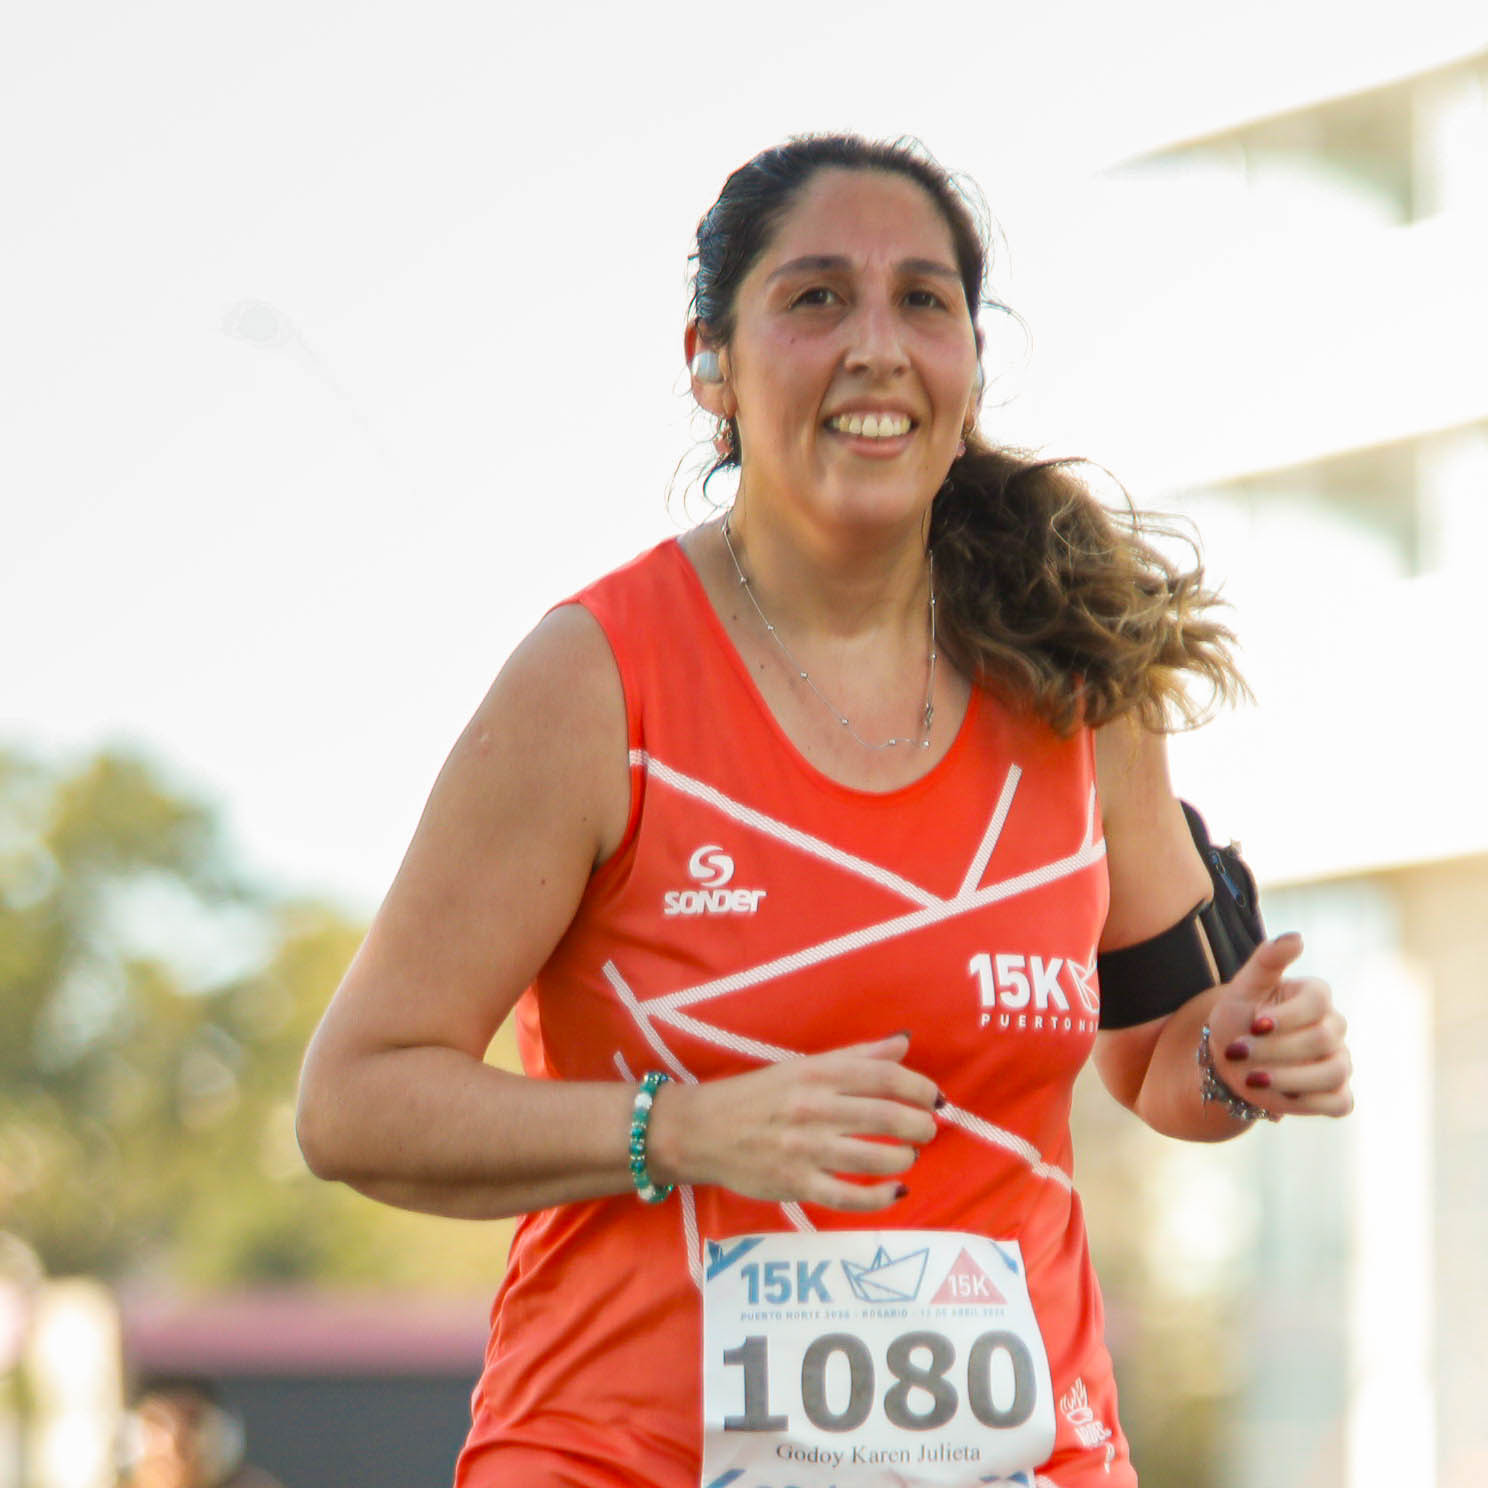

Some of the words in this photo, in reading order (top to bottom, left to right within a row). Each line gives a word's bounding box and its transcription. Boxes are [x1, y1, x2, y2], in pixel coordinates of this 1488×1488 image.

[968, 953, 1070, 1011] 15K
[980, 1013, 1072, 1031] PUERTO
[740, 1260, 833, 1305] 15K
[948, 1274, 990, 1298] 15K
[723, 1330, 1038, 1433] 1080
[776, 1443, 843, 1468] Godoy
[852, 1446, 911, 1464] Karen
[918, 1442, 982, 1463] Julieta
